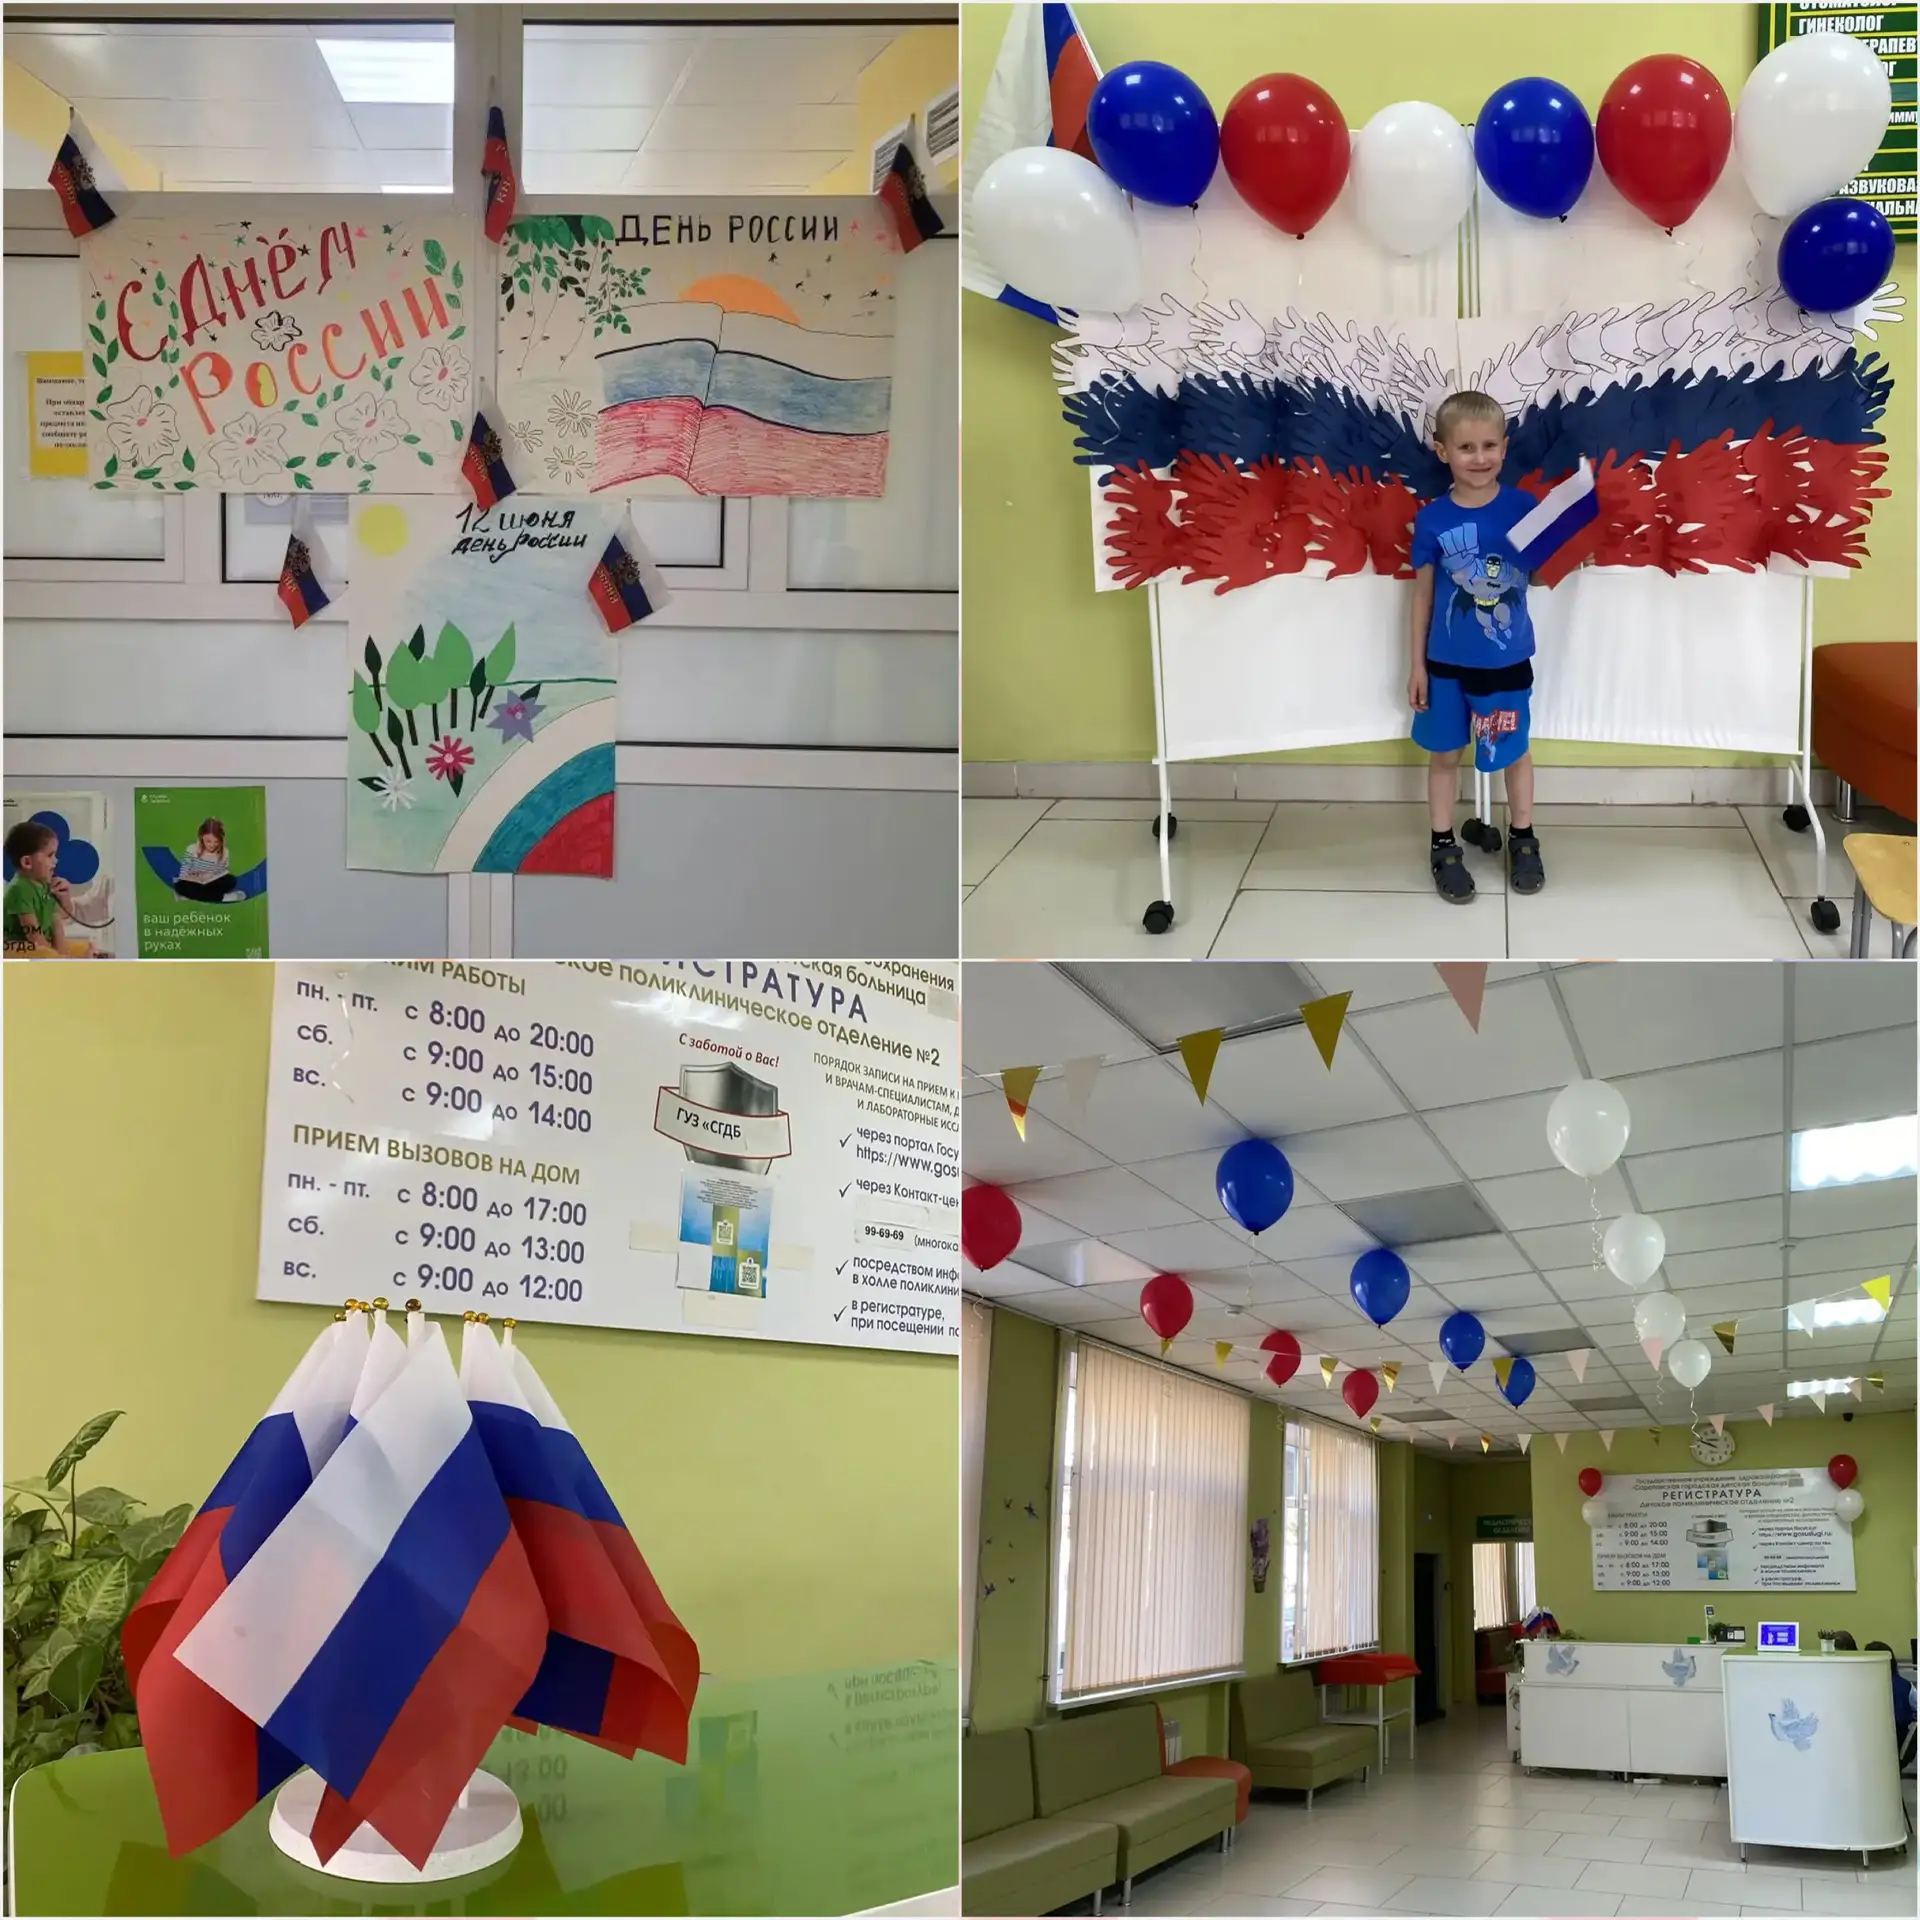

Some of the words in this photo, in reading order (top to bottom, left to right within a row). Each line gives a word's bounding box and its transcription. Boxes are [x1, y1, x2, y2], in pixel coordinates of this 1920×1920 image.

[1799, 15, 1884, 34] ГИНЕКОЛОГ
[615, 215, 711, 247] ДЕНЬ
[729, 215, 839, 244] РОССИИ
[456, 502, 490, 533] 12
[500, 510, 576, 529] июня
[451, 537, 507, 555] день
[143, 914, 170, 924] ваш
[143, 928, 152, 937] в
[144, 941, 181, 953] руках
[441, 962, 526, 996] РАБОТЫ
[846, 966, 927, 1006] больница
[405, 1005, 418, 1019] с
[429, 1000, 485, 1033] 8:00
[494, 1025, 520, 1042] до
[530, 1022, 594, 1057] 20:00
[619, 964, 813, 1030] поликлиническое
[817, 1019, 913, 1060] отделение
[916, 1047, 940, 1067] №2
[679, 1033, 687, 1045] С
[689, 1038, 743, 1059] заботой
[745, 1052, 753, 1061] о
[755, 1052, 780, 1068] Вас!
[403, 1046, 417, 1060] с
[428, 1041, 483, 1073] 9:00
[493, 1064, 519, 1082] до
[529, 1062, 592, 1095] 15:00
[813, 1052, 861, 1074] ПОРЯДОК
[863, 1065, 901, 1085] ЗАПИСИ
[902, 1075, 915, 1089] НА
[916, 1080, 948, 1097] ПРИЕМ
[950, 1089, 956, 1099] К
[402, 1087, 415, 1102] с
[426, 1081, 482, 1113] 9:00
[492, 1104, 517, 1121] до
[528, 1101, 591, 1133] 14:00
[825, 1073, 833, 1084] И
[835, 1074, 952, 1116] ВРАЧАМ-СПЕЦИАЛИСТАМ,
[676, 1107, 699, 1128] ГУЗ
[702, 1120, 742, 1140] «СГДБ
[857, 1098, 865, 1110] И
[866, 1100, 939, 1128] ЛАБОРАТОРНЫЕ
[293, 1124, 379, 1155] ПРИЕМ
[387, 1139, 493, 1172] ВЫЗОВОВ
[500, 1157, 526, 1178] НА
[531, 1162, 580, 1185] ДОМ
[856, 1126, 892, 1144] через
[894, 1135, 934, 1153] портал
[856, 1144, 960, 1178] https://www.gos
[856, 1178, 891, 1195] через
[397, 1189, 411, 1203] с
[422, 1181, 478, 1212] 8:00
[486, 1202, 513, 1218] до
[524, 1197, 587, 1226] 17:00
[395, 1230, 409, 1245] с
[420, 1223, 476, 1252] 9:00
[484, 1242, 511, 1258] до
[521, 1235, 585, 1265] 13:00
[864, 1225, 904, 1241] 99-69-69
[393, 1272, 407, 1286] с
[417, 1263, 474, 1293] 9:00
[482, 1281, 509, 1298] до
[519, 1274, 583, 1303] 12:00
[852, 1274, 859, 1285] в
[861, 1275, 897, 1289] холле
[853, 1257, 933, 1278] посредством
[936, 1267, 960, 1282] инф
[851, 1317, 874, 1331] при
[877, 1319, 944, 1336] посещении
[852, 1300, 858, 1310] в
[860, 1300, 945, 1321] регистратуре,
[1663, 1489, 1762, 1500] РЕГИСТРАТУРА
